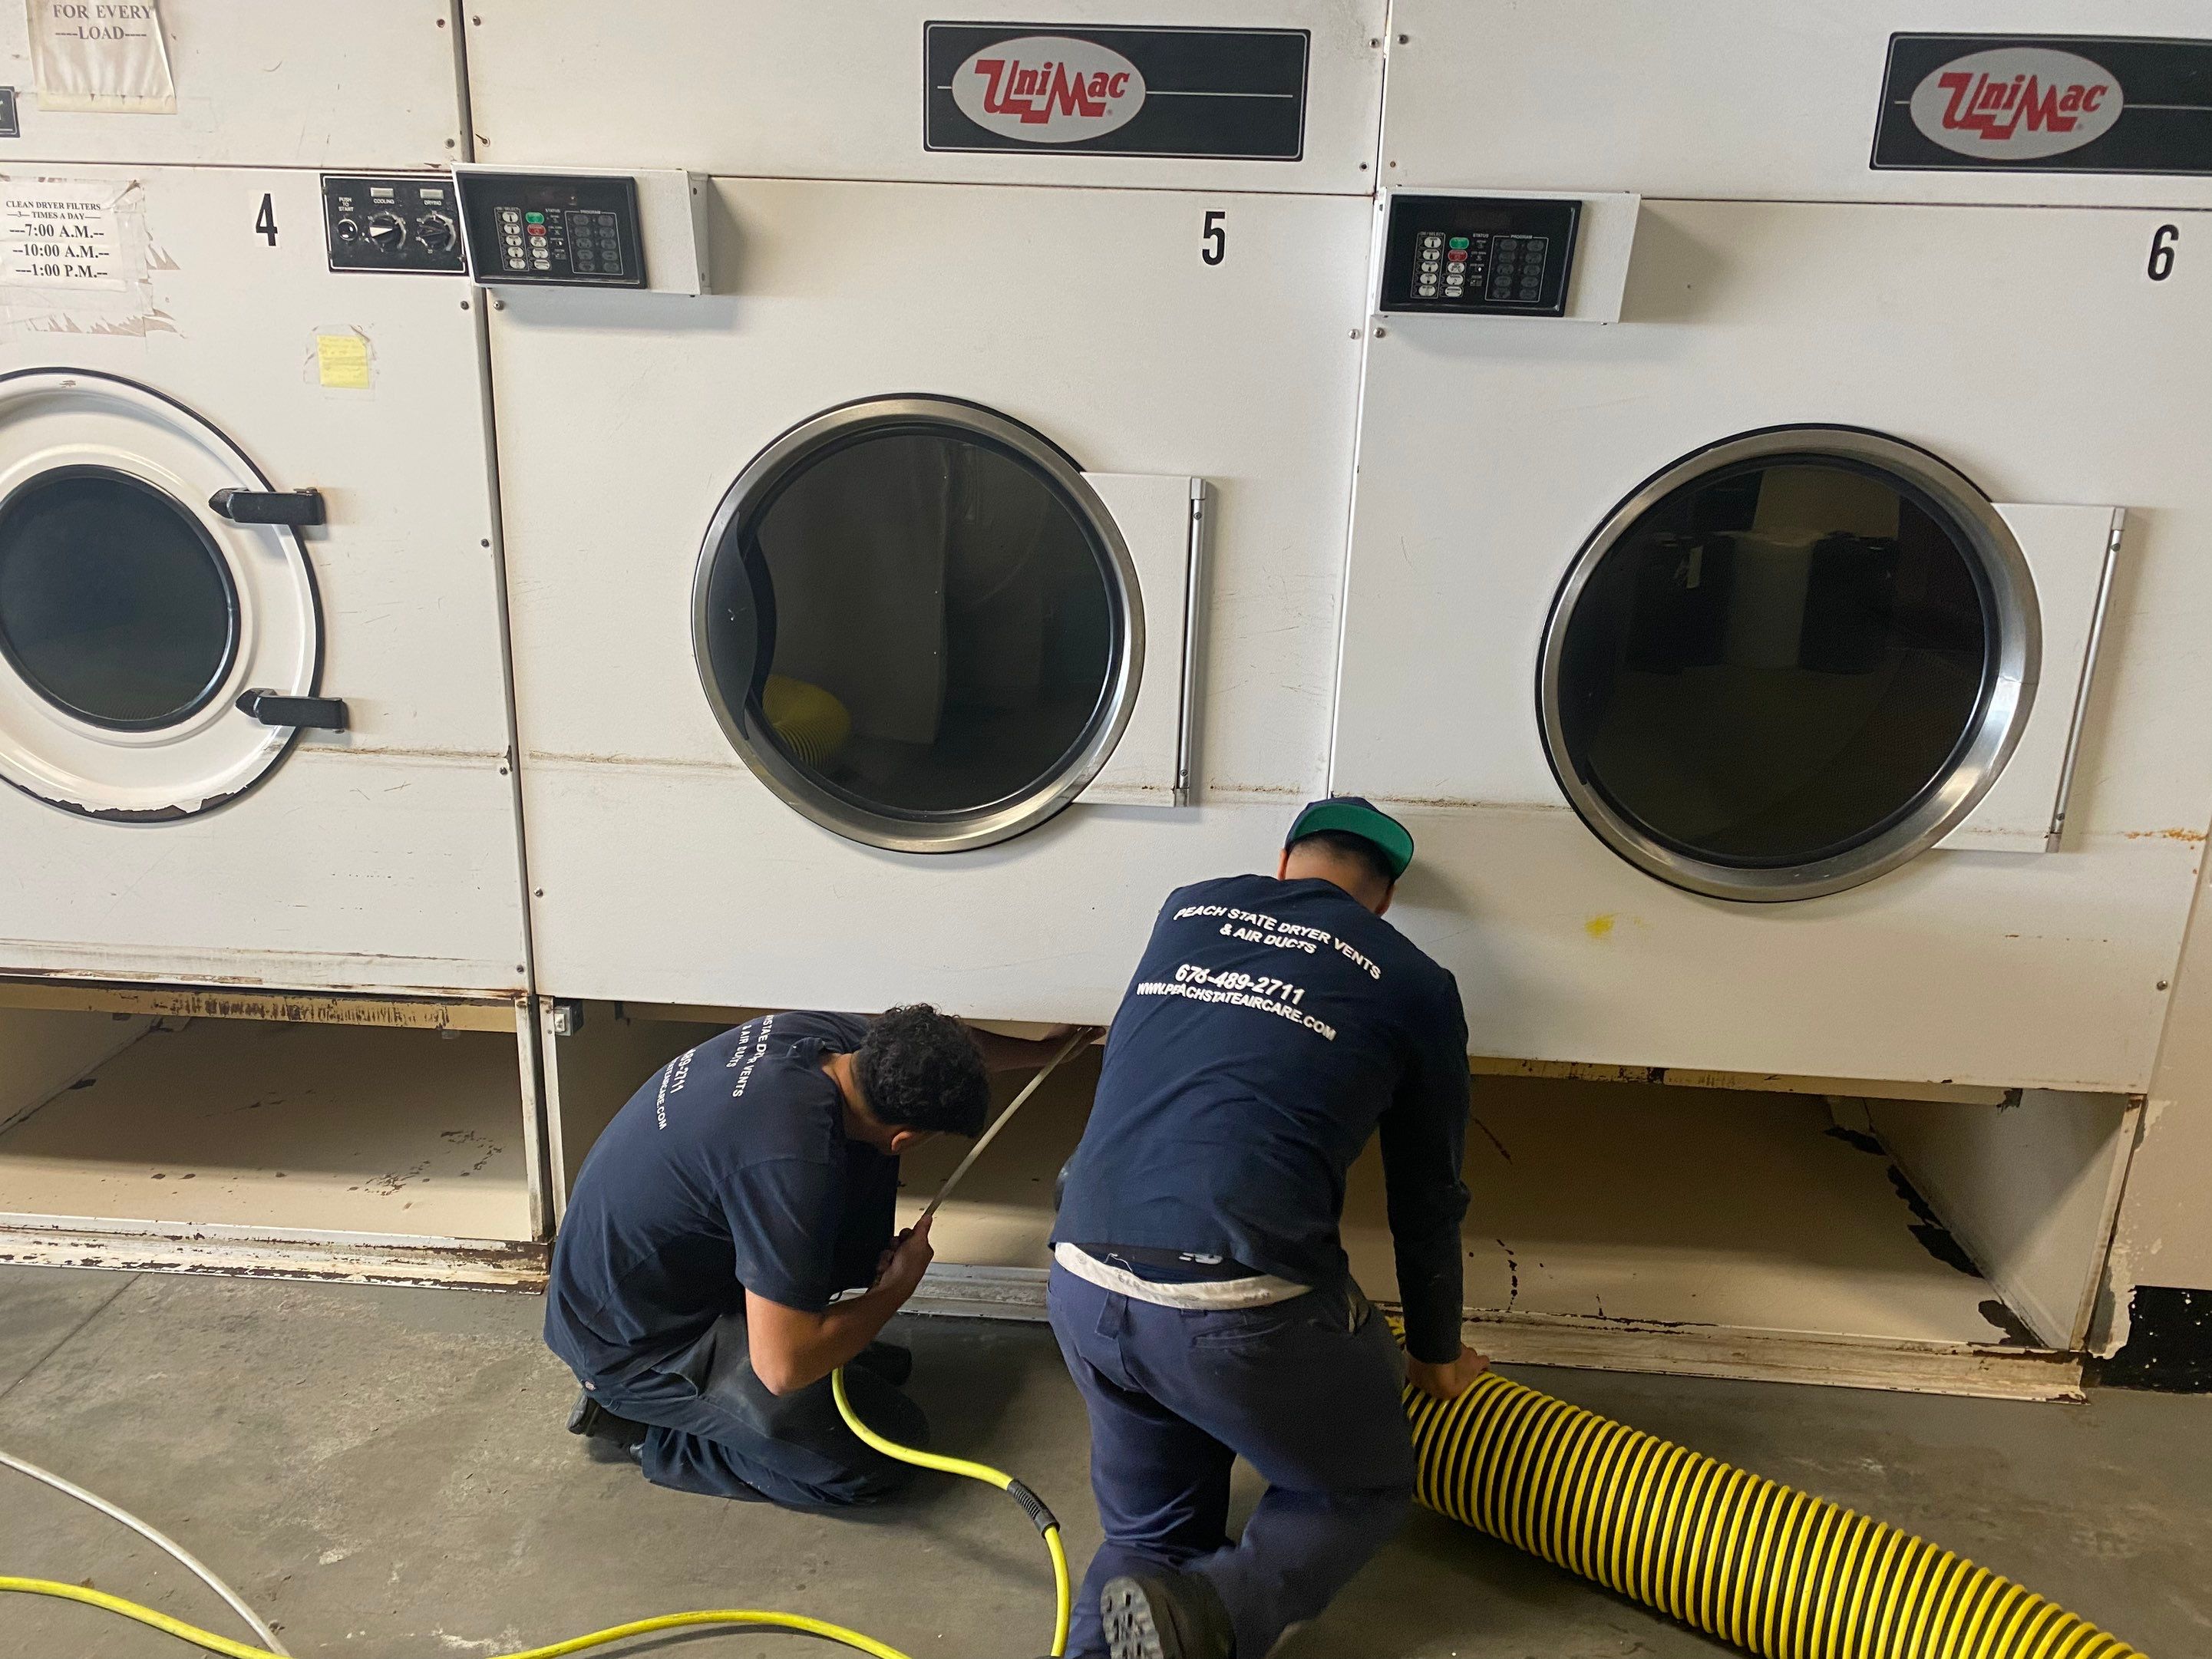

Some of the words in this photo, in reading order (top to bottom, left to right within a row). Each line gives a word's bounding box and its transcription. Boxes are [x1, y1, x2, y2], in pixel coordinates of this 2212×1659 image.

[53, 4, 89, 18] FOR
[97, 5, 152, 19] EVERY
[974, 58, 1131, 124] UniMac
[1937, 71, 2109, 140] UniMac
[256, 193, 278, 247] 4
[1201, 211, 1226, 266] 5
[2147, 224, 2180, 282] 6
[1174, 905, 1228, 921] PEACH
[1227, 908, 1277, 931] STATE
[1277, 922, 1331, 945] DRYER
[1334, 937, 1382, 980] VENTS
[1219, 923, 1232, 935] &
[1233, 928, 1263, 943] AIR
[1263, 934, 1318, 954] DUCTS
[738, 1031, 751, 1044] AIR
[732, 1064, 754, 1097] VENTS
